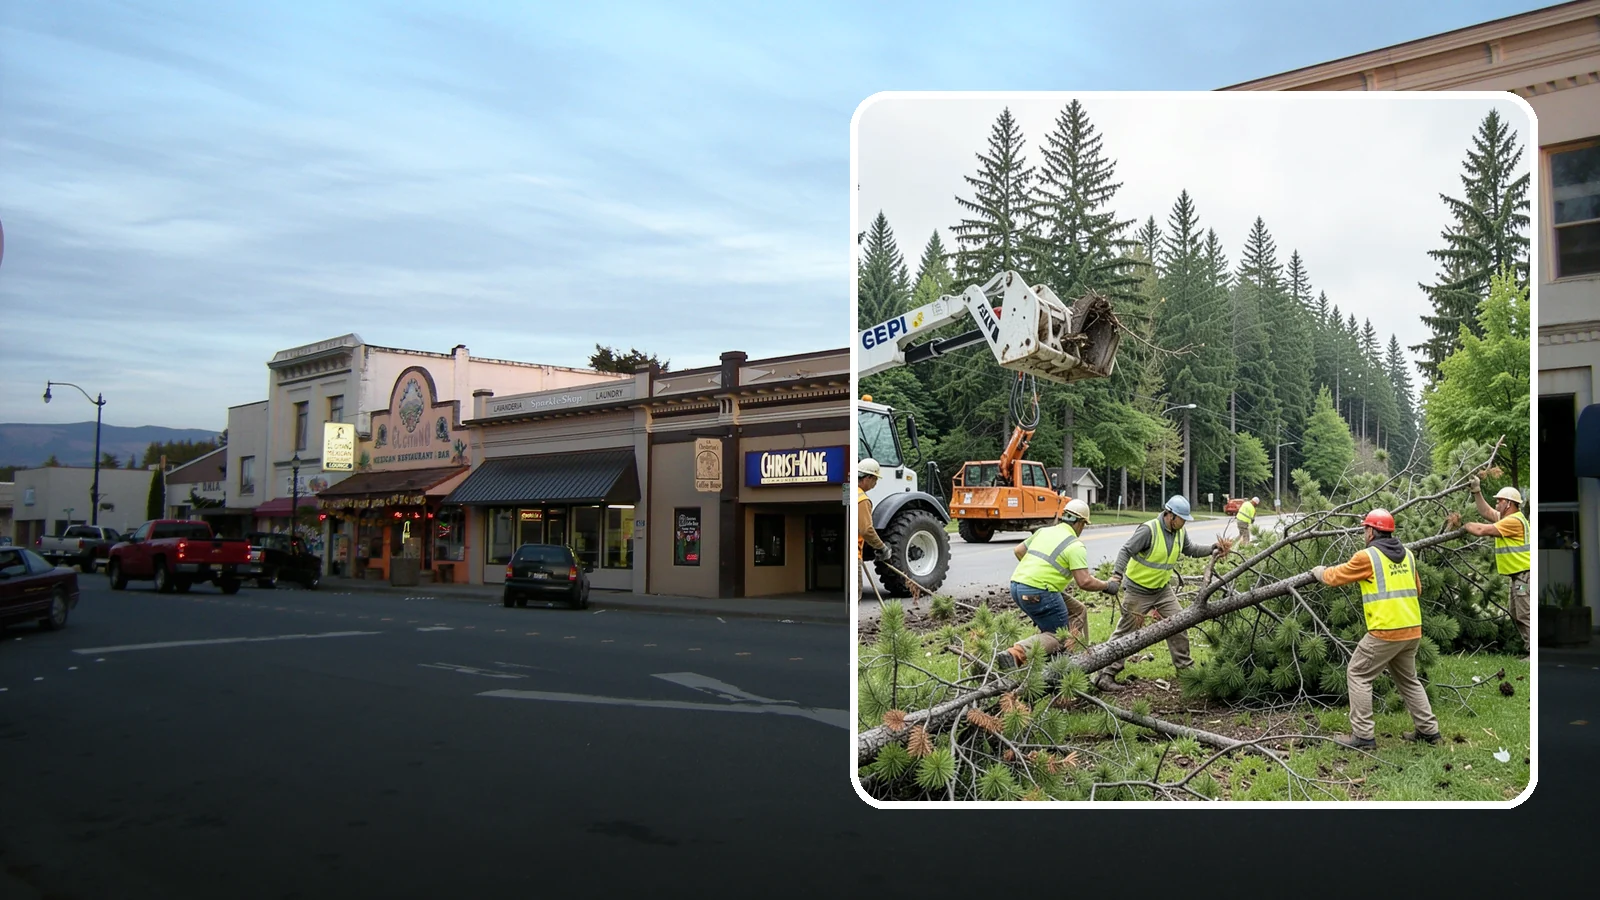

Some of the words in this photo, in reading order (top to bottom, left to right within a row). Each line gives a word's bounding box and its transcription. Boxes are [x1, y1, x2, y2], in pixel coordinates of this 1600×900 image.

[862, 315, 908, 350] GEPI
[595, 389, 623, 400] LAUNDRY
[493, 402, 522, 413] LAVANDERIA
[373, 454, 396, 465] MEXICAN
[397, 451, 434, 463] RESTAURANT
[437, 450, 450, 460] BAR
[760, 452, 798, 478] CHRIST
[799, 450, 827, 476] KING
[696, 480, 709, 489] Coffee
